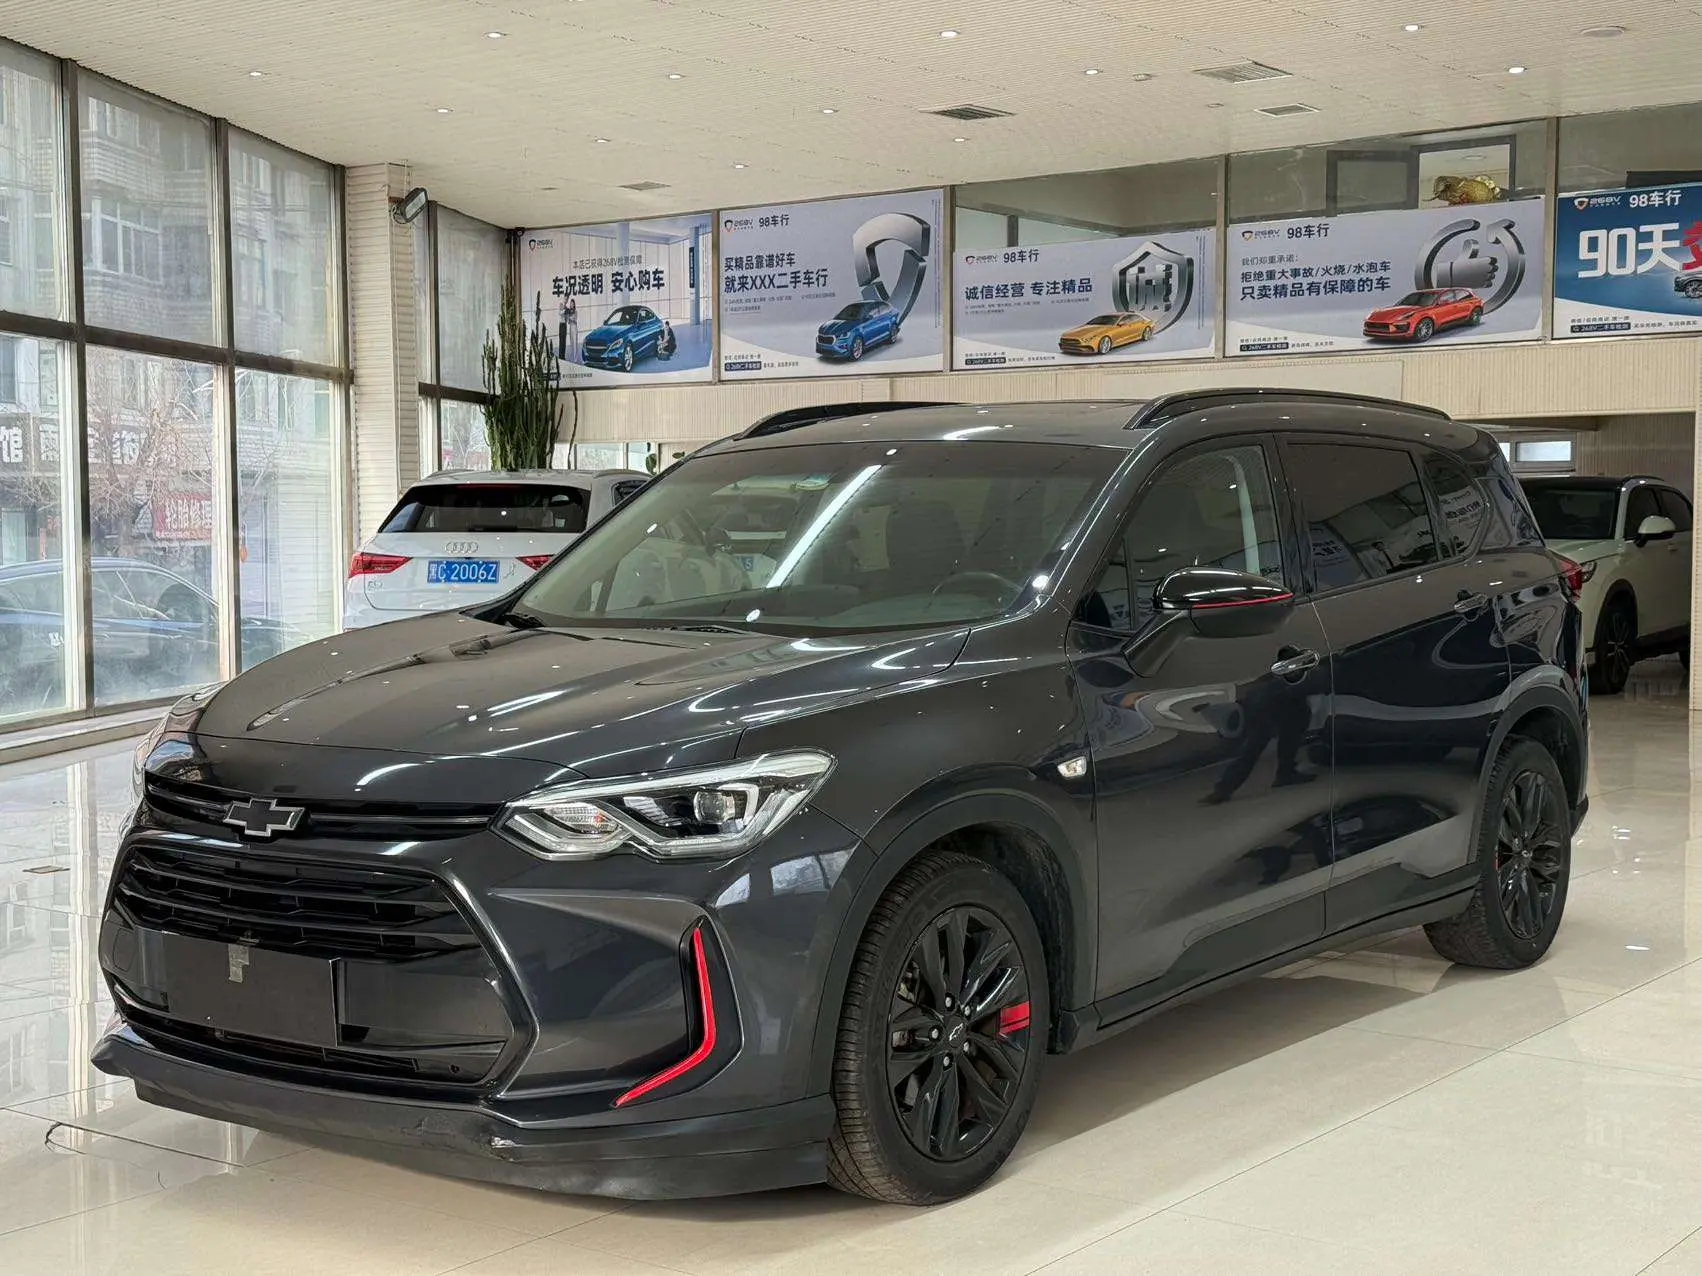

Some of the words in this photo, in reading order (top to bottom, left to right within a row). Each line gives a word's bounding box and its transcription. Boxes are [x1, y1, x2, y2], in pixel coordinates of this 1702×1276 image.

[1629, 189, 1682, 208] 98车行
[758, 214, 790, 227] 98车行
[1287, 223, 1330, 239] 98车行
[724, 253, 796, 272] 买精品靠谱好车
[1003, 249, 1040, 264] 98车行
[724, 269, 829, 294] 就来XXX二手车行
[1240, 260, 1392, 284] 拒绝重大事故/火烧/水泡车
[552, 273, 603, 298] 车况透明
[611, 268, 665, 293] 安心购车
[964, 282, 1025, 301] 诚信经营
[1030, 277, 1093, 297] 专注精品
[1240, 276, 1392, 301] 只卖精品有保障的车
